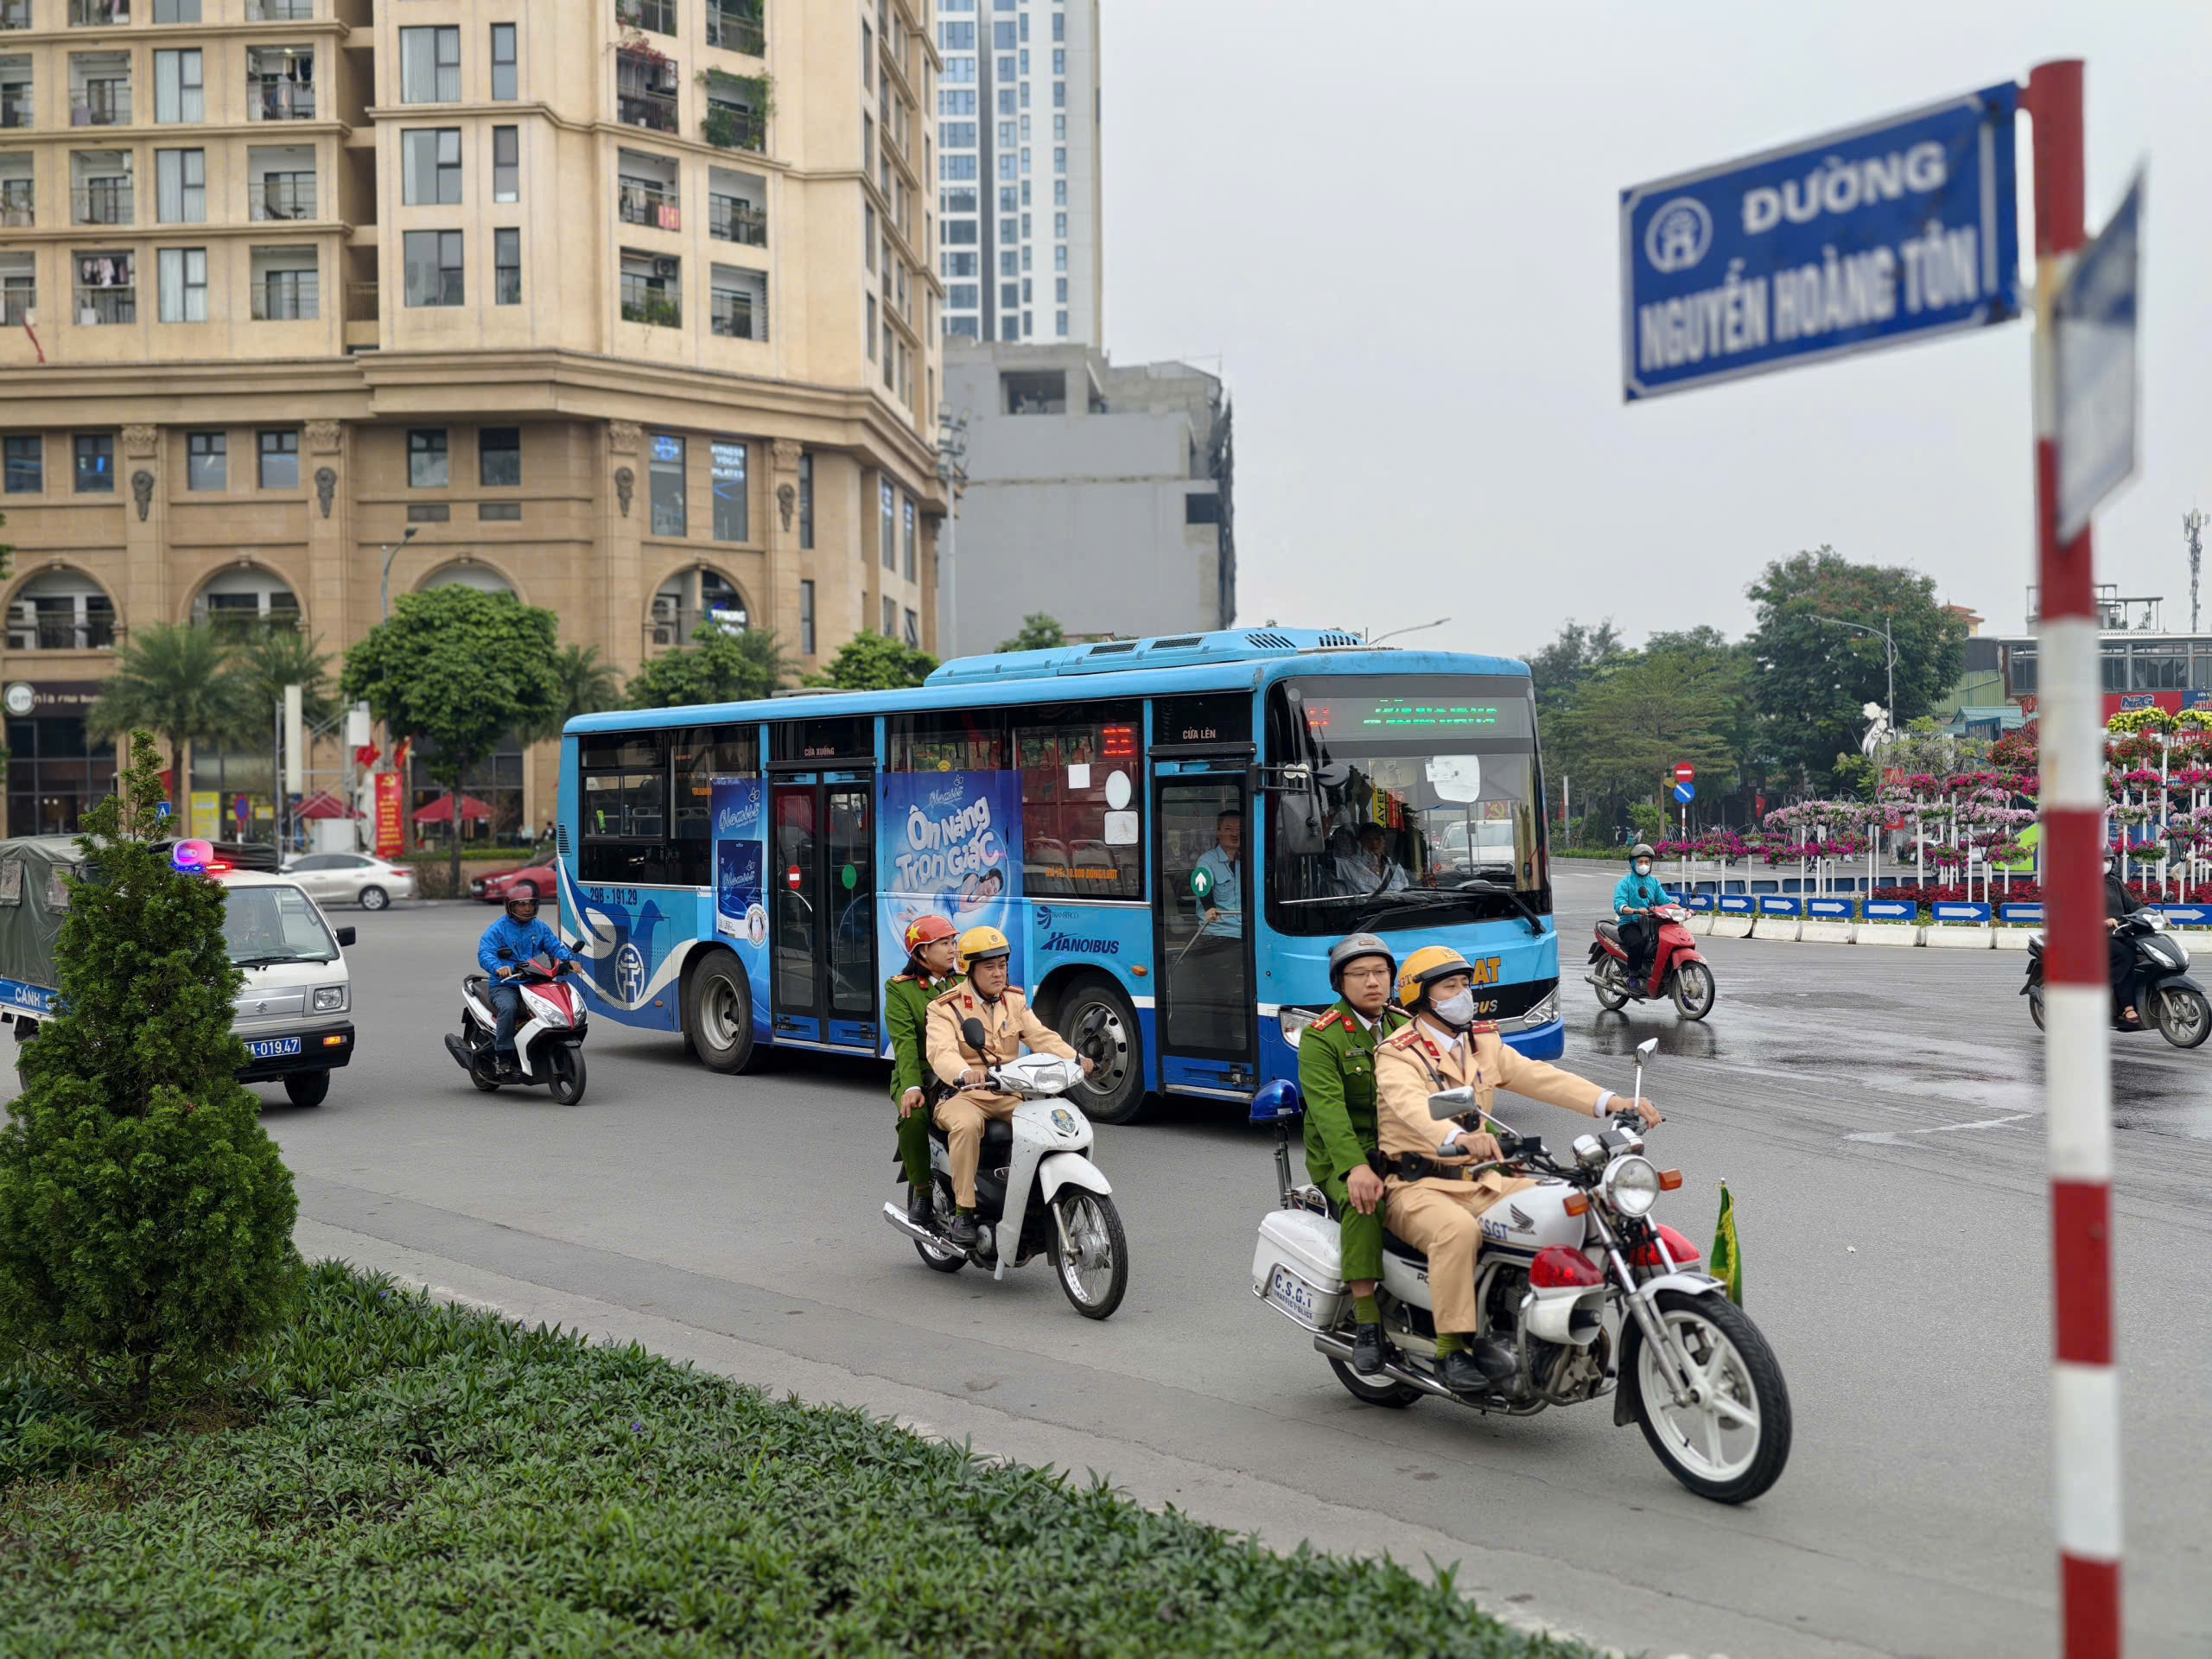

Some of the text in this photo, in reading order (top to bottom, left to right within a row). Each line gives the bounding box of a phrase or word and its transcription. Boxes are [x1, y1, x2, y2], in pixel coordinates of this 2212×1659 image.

[1774, 245, 1897, 342] HOÀNG
[1183, 726, 1216, 740] CỬA LÊN
[941, 796, 991, 846] Nàng
[895, 854, 945, 891] Trọn
[589, 887, 604, 903] 29B
[612, 888, 638, 906] 191.29
[1039, 932, 1120, 954] HANOIBUS
